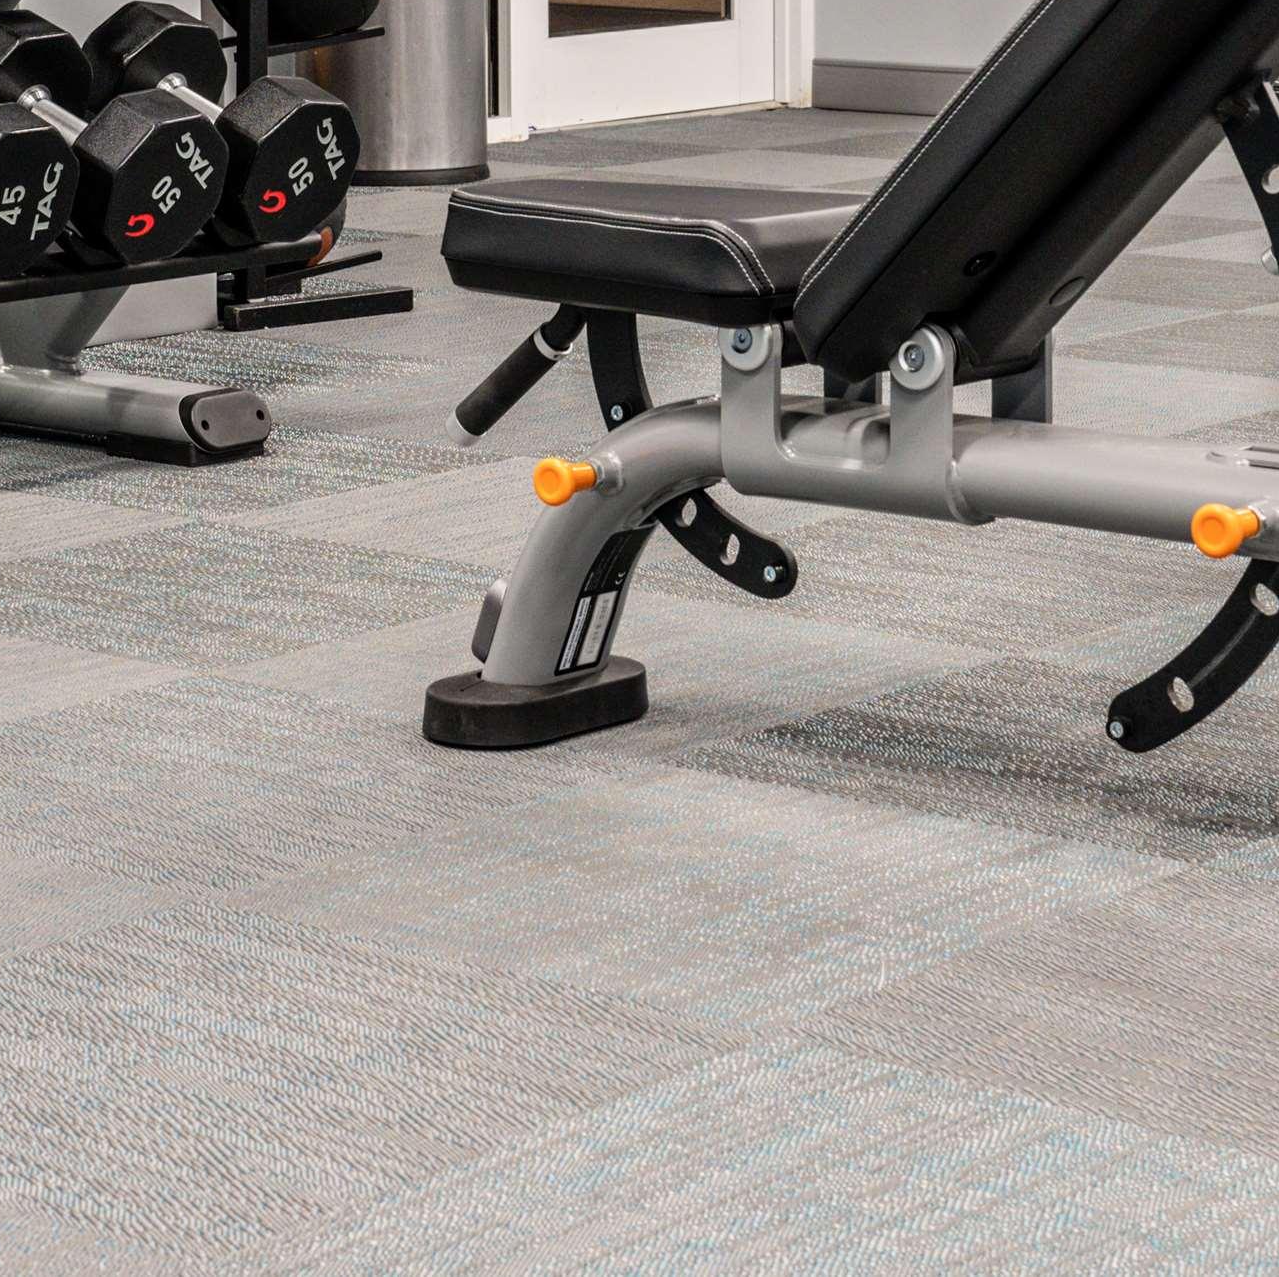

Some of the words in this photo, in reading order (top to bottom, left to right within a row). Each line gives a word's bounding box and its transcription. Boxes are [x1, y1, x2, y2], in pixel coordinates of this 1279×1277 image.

[176, 132, 213, 189] TAG
[317, 118, 345, 180] TAG
[152, 176, 181, 213] 50
[289, 157, 313, 196] 50
[0, 186, 25, 225] 45
[30, 162, 63, 240] TAG
